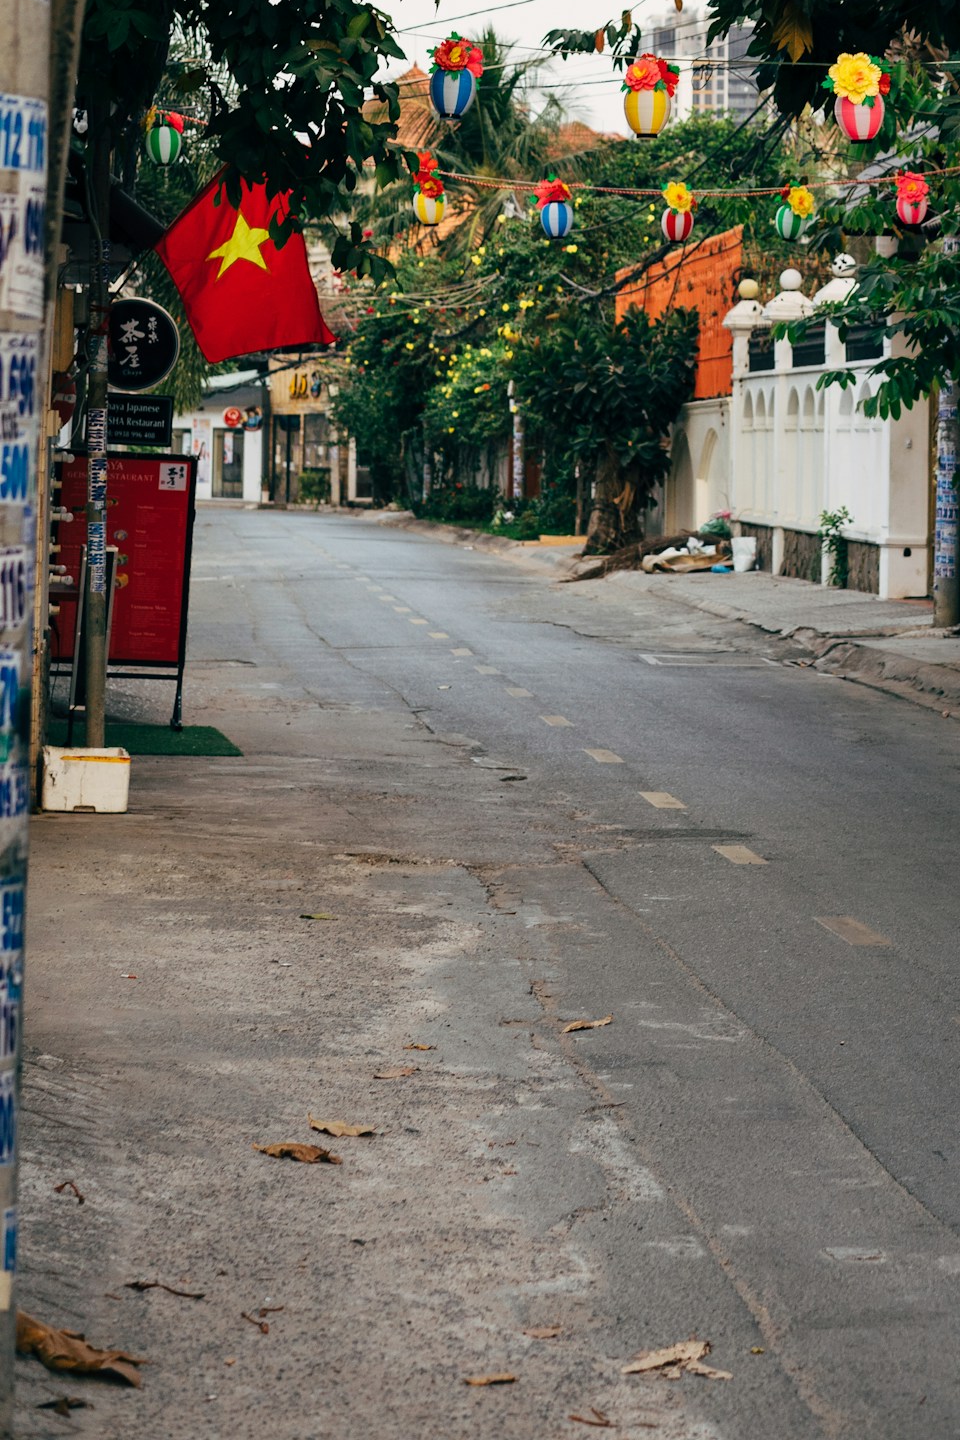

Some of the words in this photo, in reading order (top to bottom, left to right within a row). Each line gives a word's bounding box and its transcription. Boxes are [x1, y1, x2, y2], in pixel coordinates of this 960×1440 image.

[107, 402, 124, 411] haya
[126, 402, 160, 414] Japanese
[108, 415, 124, 426] SHA
[126, 416, 165, 429] Restaurant
[67, 471, 88, 479] GEIS
